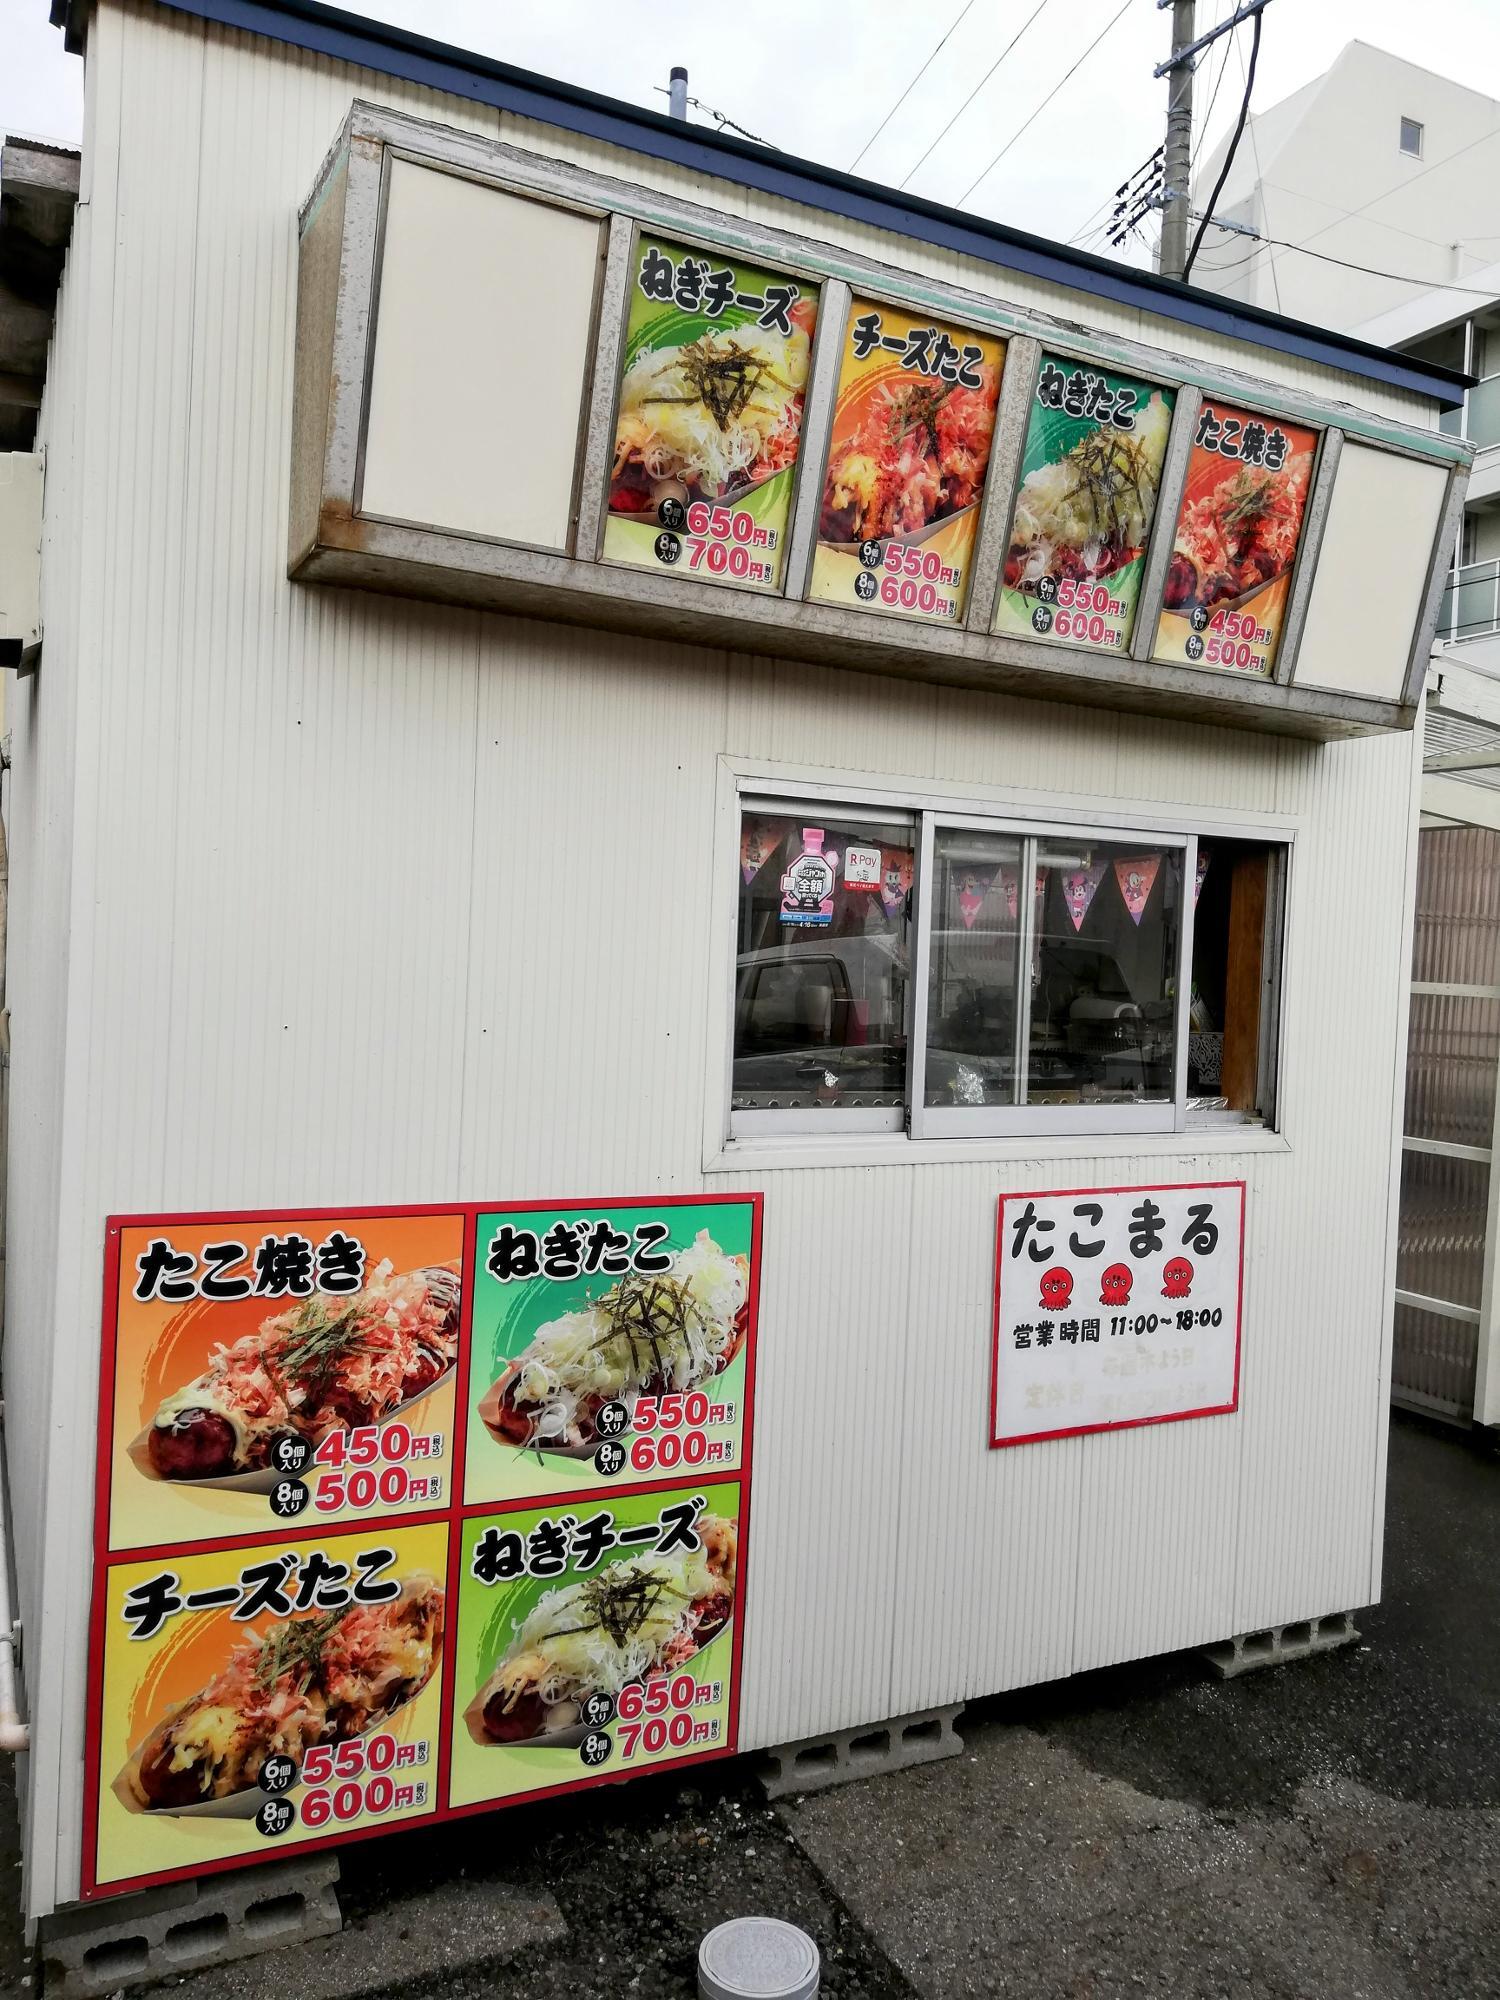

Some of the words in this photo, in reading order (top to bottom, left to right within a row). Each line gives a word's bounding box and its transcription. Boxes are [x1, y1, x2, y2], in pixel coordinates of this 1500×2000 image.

[640, 248, 799, 335] ねぎチーズ
[853, 313, 983, 389] チーズたこ
[1037, 363, 1138, 429] ねぎたこ
[1195, 409, 1288, 469] たこ焼き
[799, 879, 824, 893] 全額
[850, 853, 857, 865] R
[860, 854, 877, 867] Pay
[485, 1220, 671, 1281] ねぎたこ
[1011, 1199, 1219, 1262] たこまる
[134, 1231, 366, 1301] たこ焼き
[1013, 1318, 1100, 1350] 営業時間
[470, 1495, 708, 1585] ねぎチーズ
[122, 1547, 401, 1640] チーズたこ
